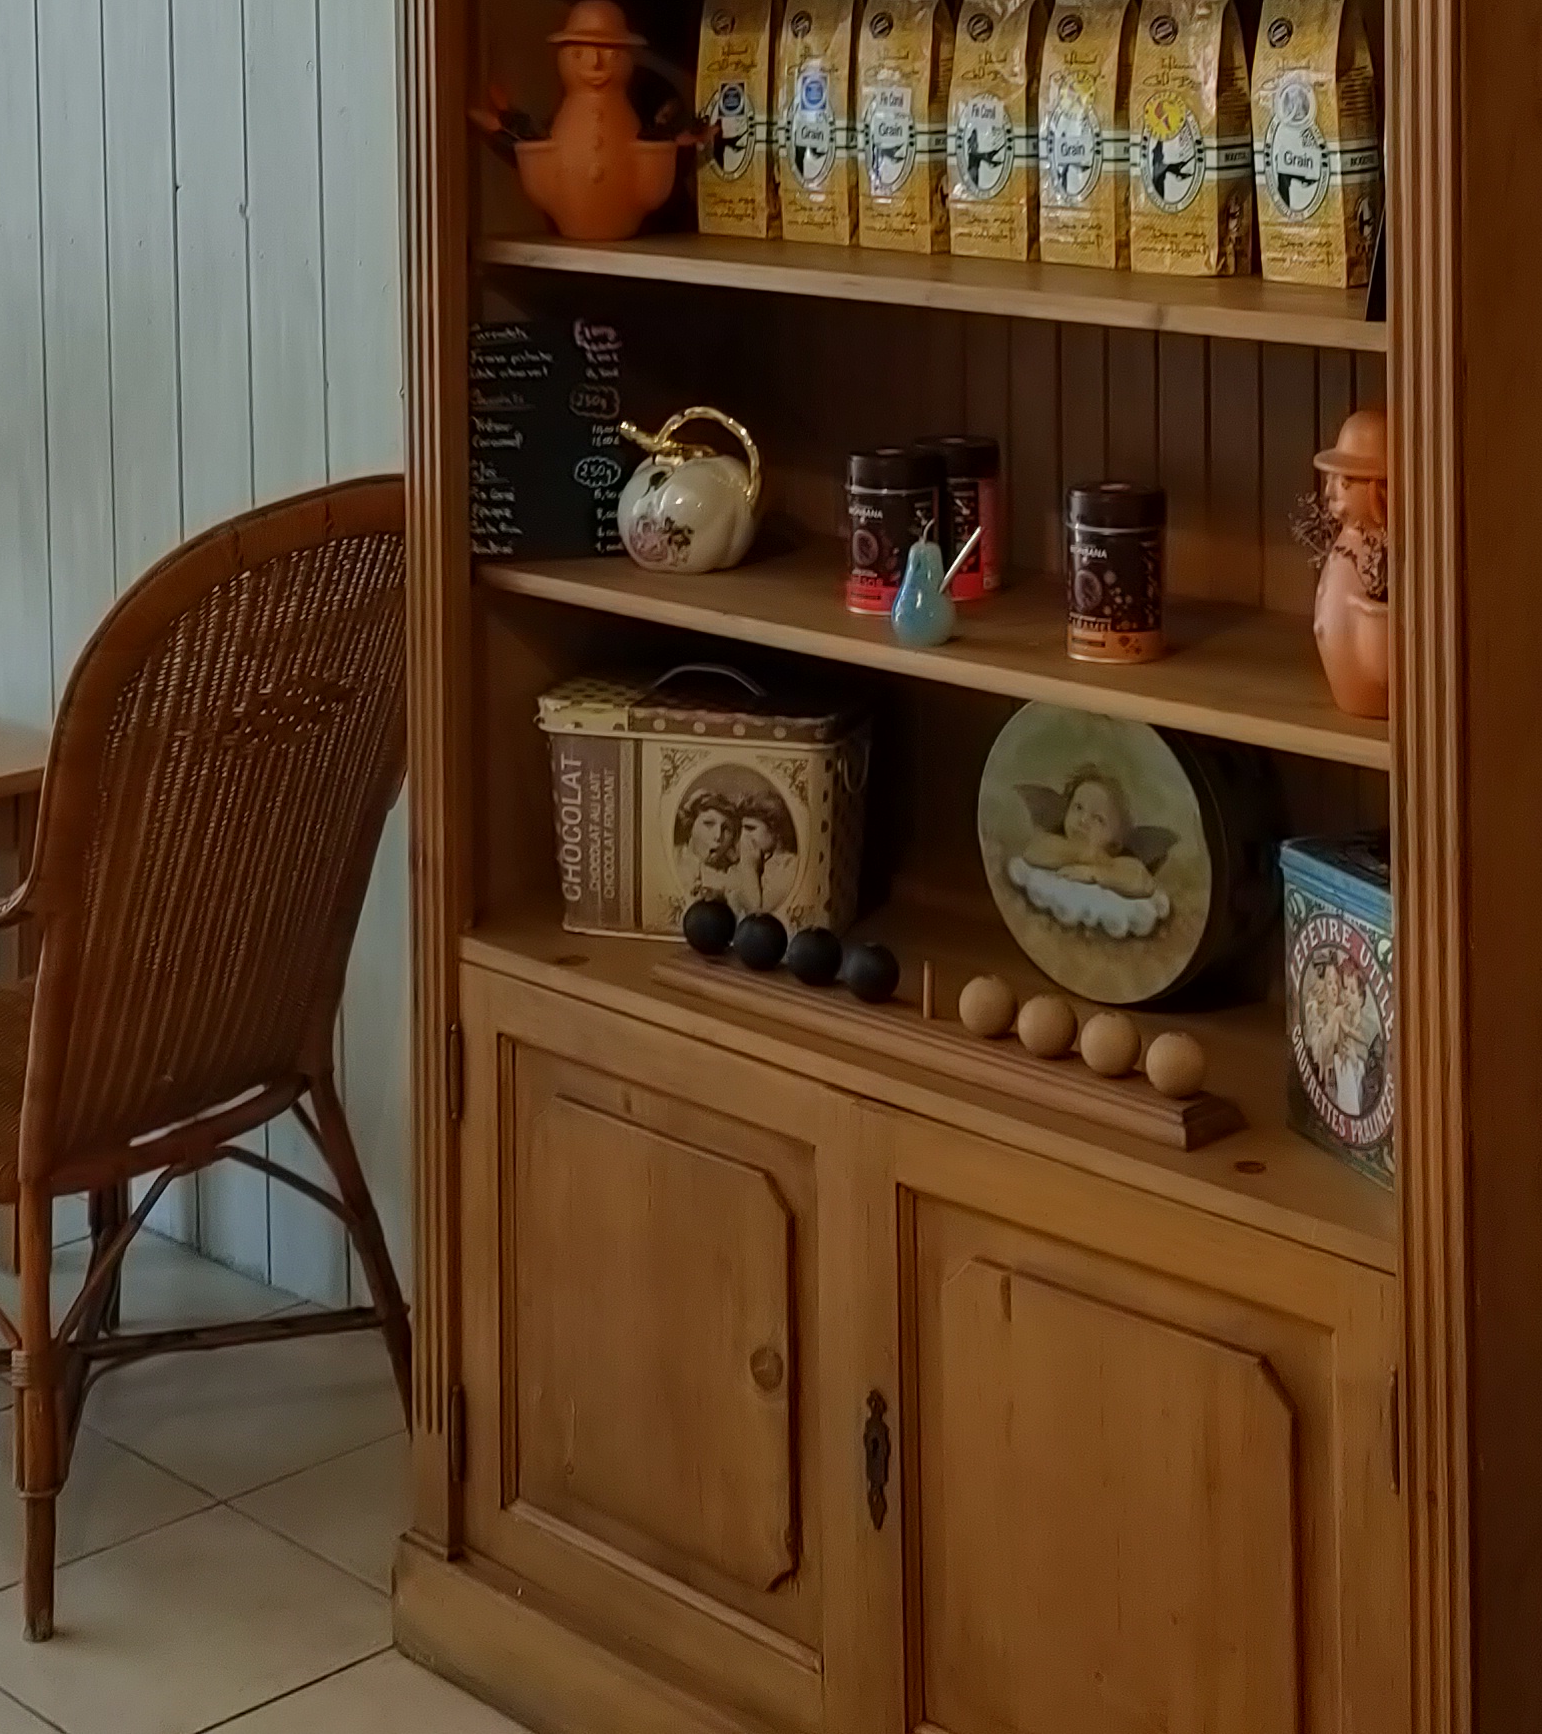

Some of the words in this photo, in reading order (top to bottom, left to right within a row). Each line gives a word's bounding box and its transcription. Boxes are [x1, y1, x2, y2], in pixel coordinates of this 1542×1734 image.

[801, 125, 824, 141] Grain
[878, 122, 903, 136] Grain
[1060, 139, 1086, 157] Grain
[1283, 151, 1314, 169] Grain
[561, 752, 583, 902] CHOCOLAT
[1290, 917, 1353, 991] LEFEVRE
